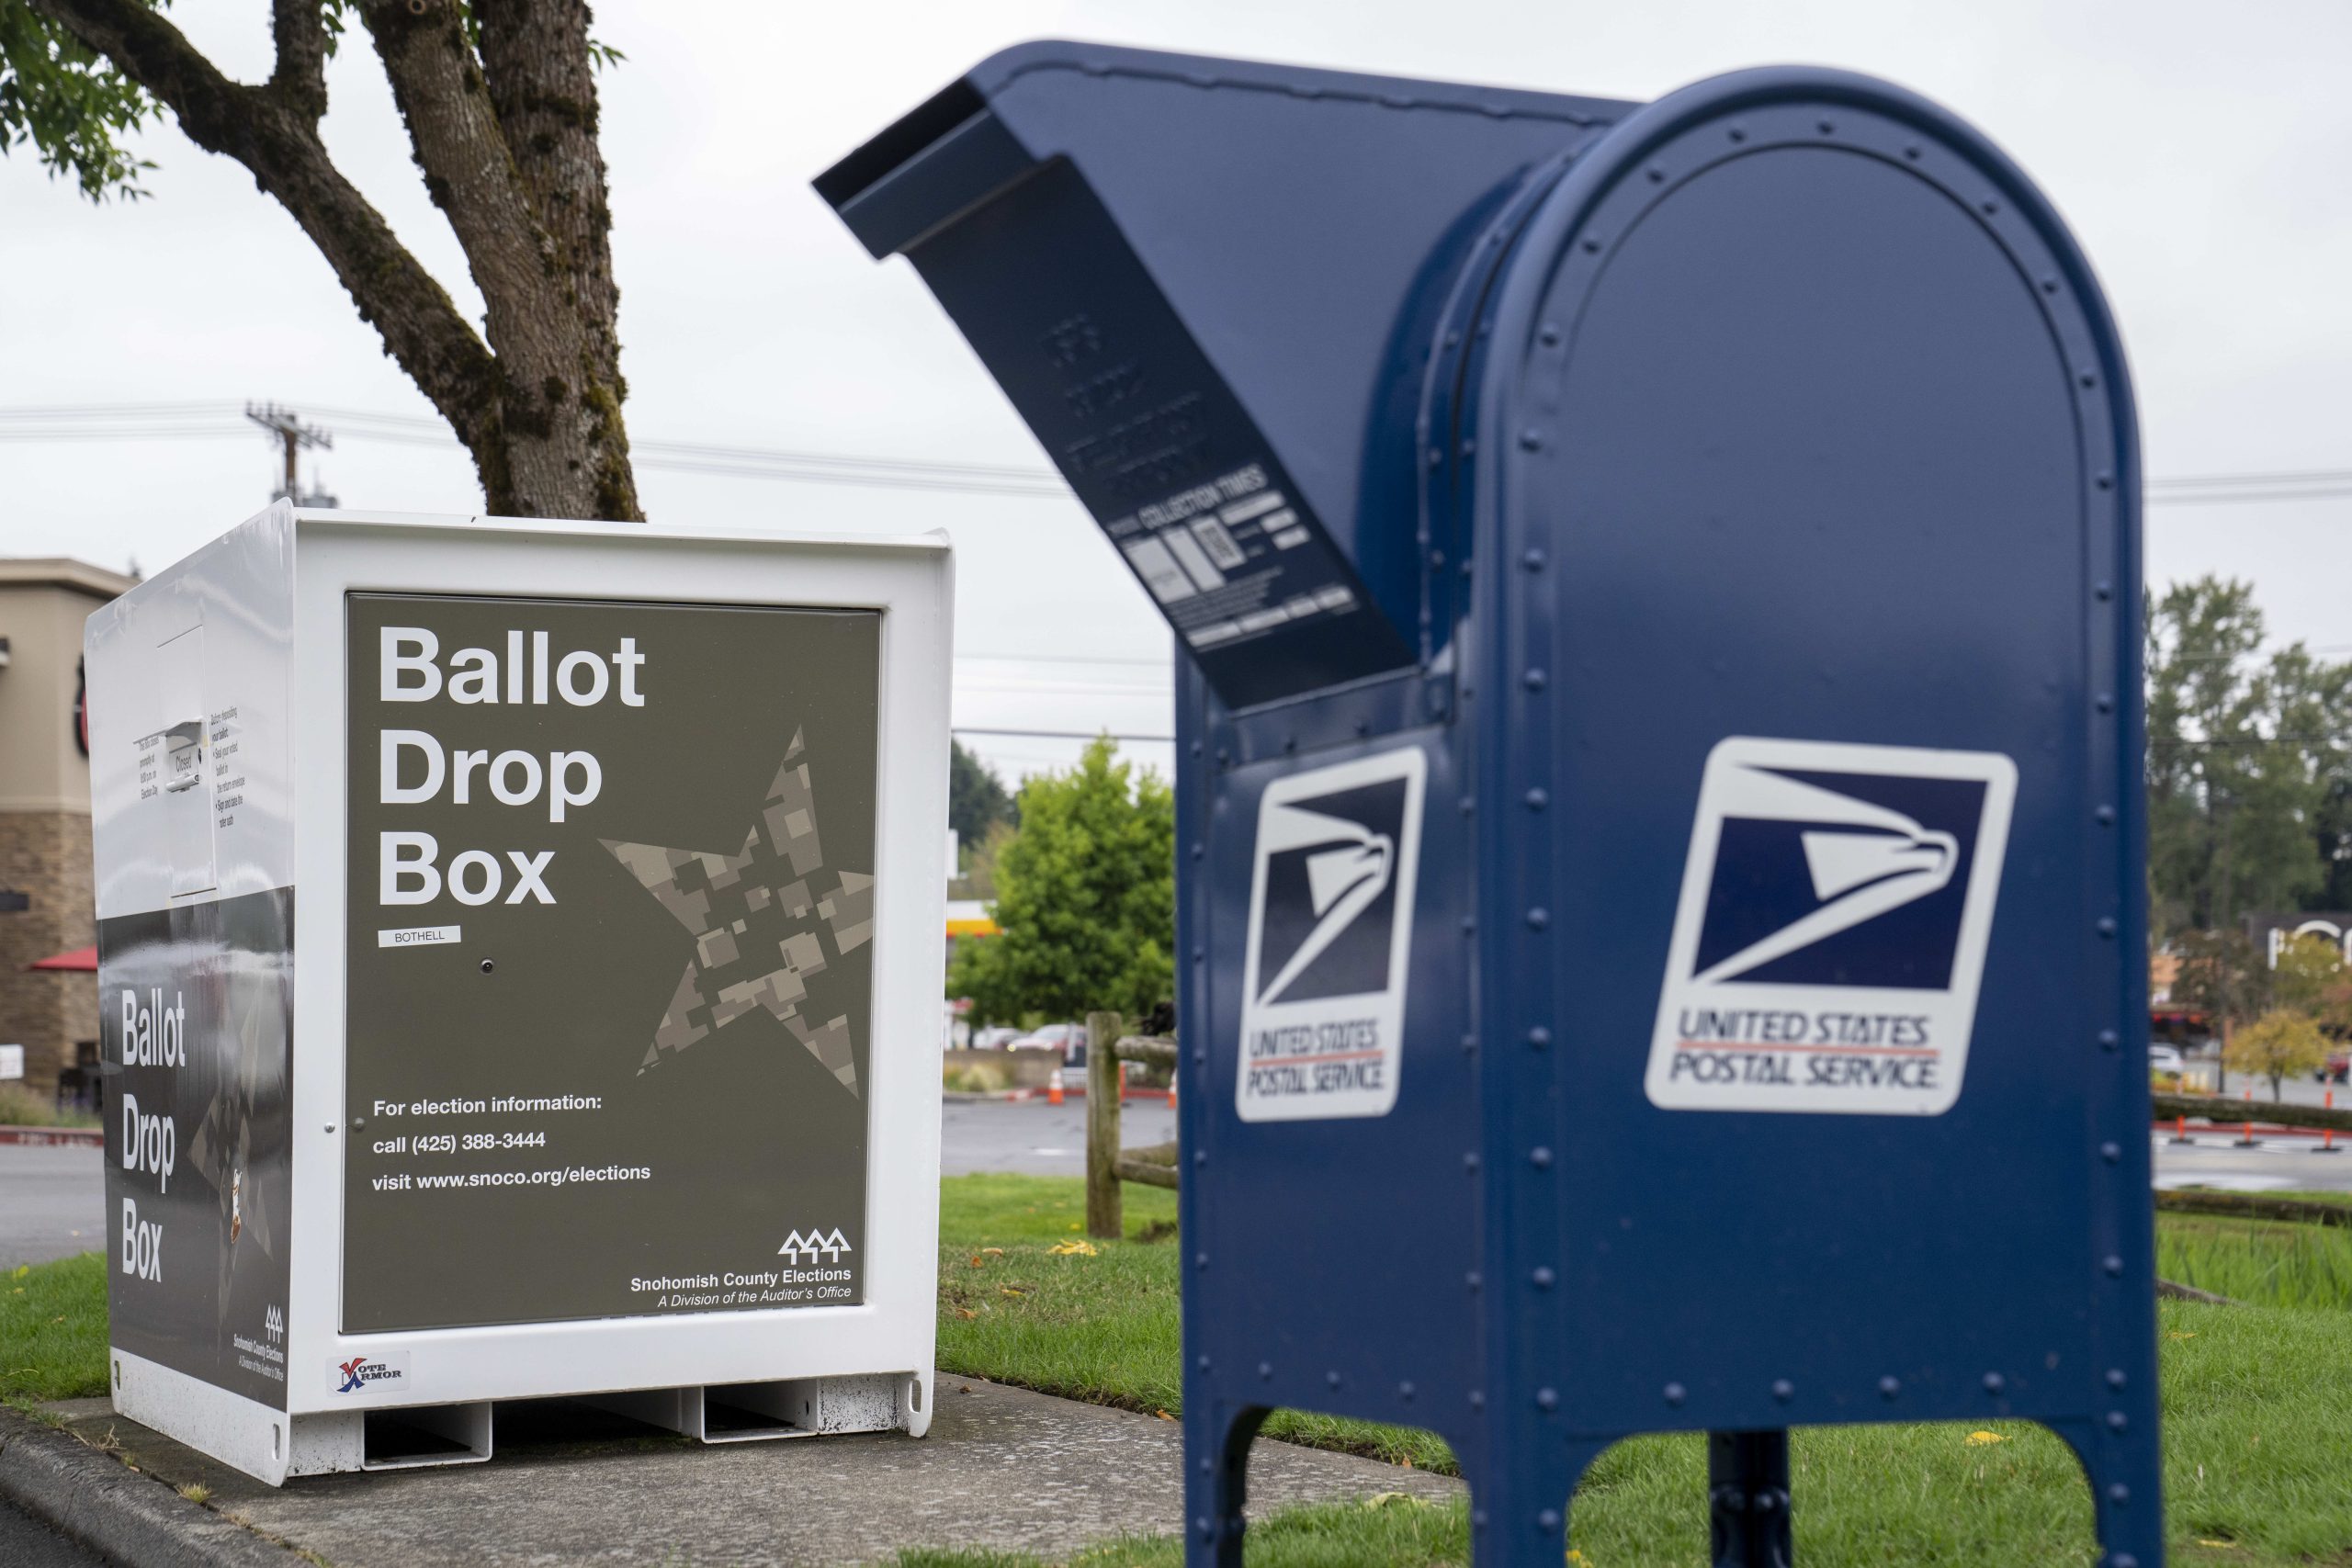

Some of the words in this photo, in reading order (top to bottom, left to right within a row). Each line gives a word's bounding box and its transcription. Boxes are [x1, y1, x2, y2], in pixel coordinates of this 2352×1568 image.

[380, 626, 645, 707] Ballot
[175, 753, 192, 773] Closed
[380, 729, 603, 823] Drop
[379, 831, 557, 907] Box
[394, 931, 446, 943] BOTHELL
[122, 987, 186, 1067] Ballot
[1250, 1025, 1312, 1057] UNITED
[1317, 1018, 1380, 1053] STATES
[1679, 1007, 1808, 1043] UNITED
[1814, 1011, 1930, 1047] STATES
[1247, 1066, 1308, 1098] POSTAL
[1313, 1058, 1385, 1094] SERVICE
[1669, 1051, 1795, 1086] POSTAL
[1804, 1055, 1940, 1090] SERVICE
[373, 1100, 405, 1117] For
[411, 1097, 486, 1115] election
[492, 1094, 603, 1113] information:
[122, 1093, 175, 1193] Drop
[372, 1136, 406, 1154] call
[412, 1134, 457, 1156] (425)
[462, 1132, 546, 1150] 388-3444
[372, 1174, 411, 1191] visit
[416, 1165, 650, 1189] www.snoco.org/elections
[122, 1198, 163, 1283] Box
[630, 1274, 718, 1292] Snohomish
[723, 1271, 778, 1291] County
[783, 1268, 852, 1283] Elections
[658, 1294, 669, 1307] A
[671, 1292, 719, 1306] Division
[722, 1292, 737, 1304] of
[738, 1291, 757, 1303] the
[760, 1287, 813, 1302] Auditor's
[817, 1286, 852, 1299] Office
[233, 1333, 253, 1353] Snohomish
[254, 1339, 266, 1360] County
[266, 1344, 284, 1364] Elections
[336, 1370, 402, 1393] ARMOR
[339, 1358, 387, 1379] VOTE
